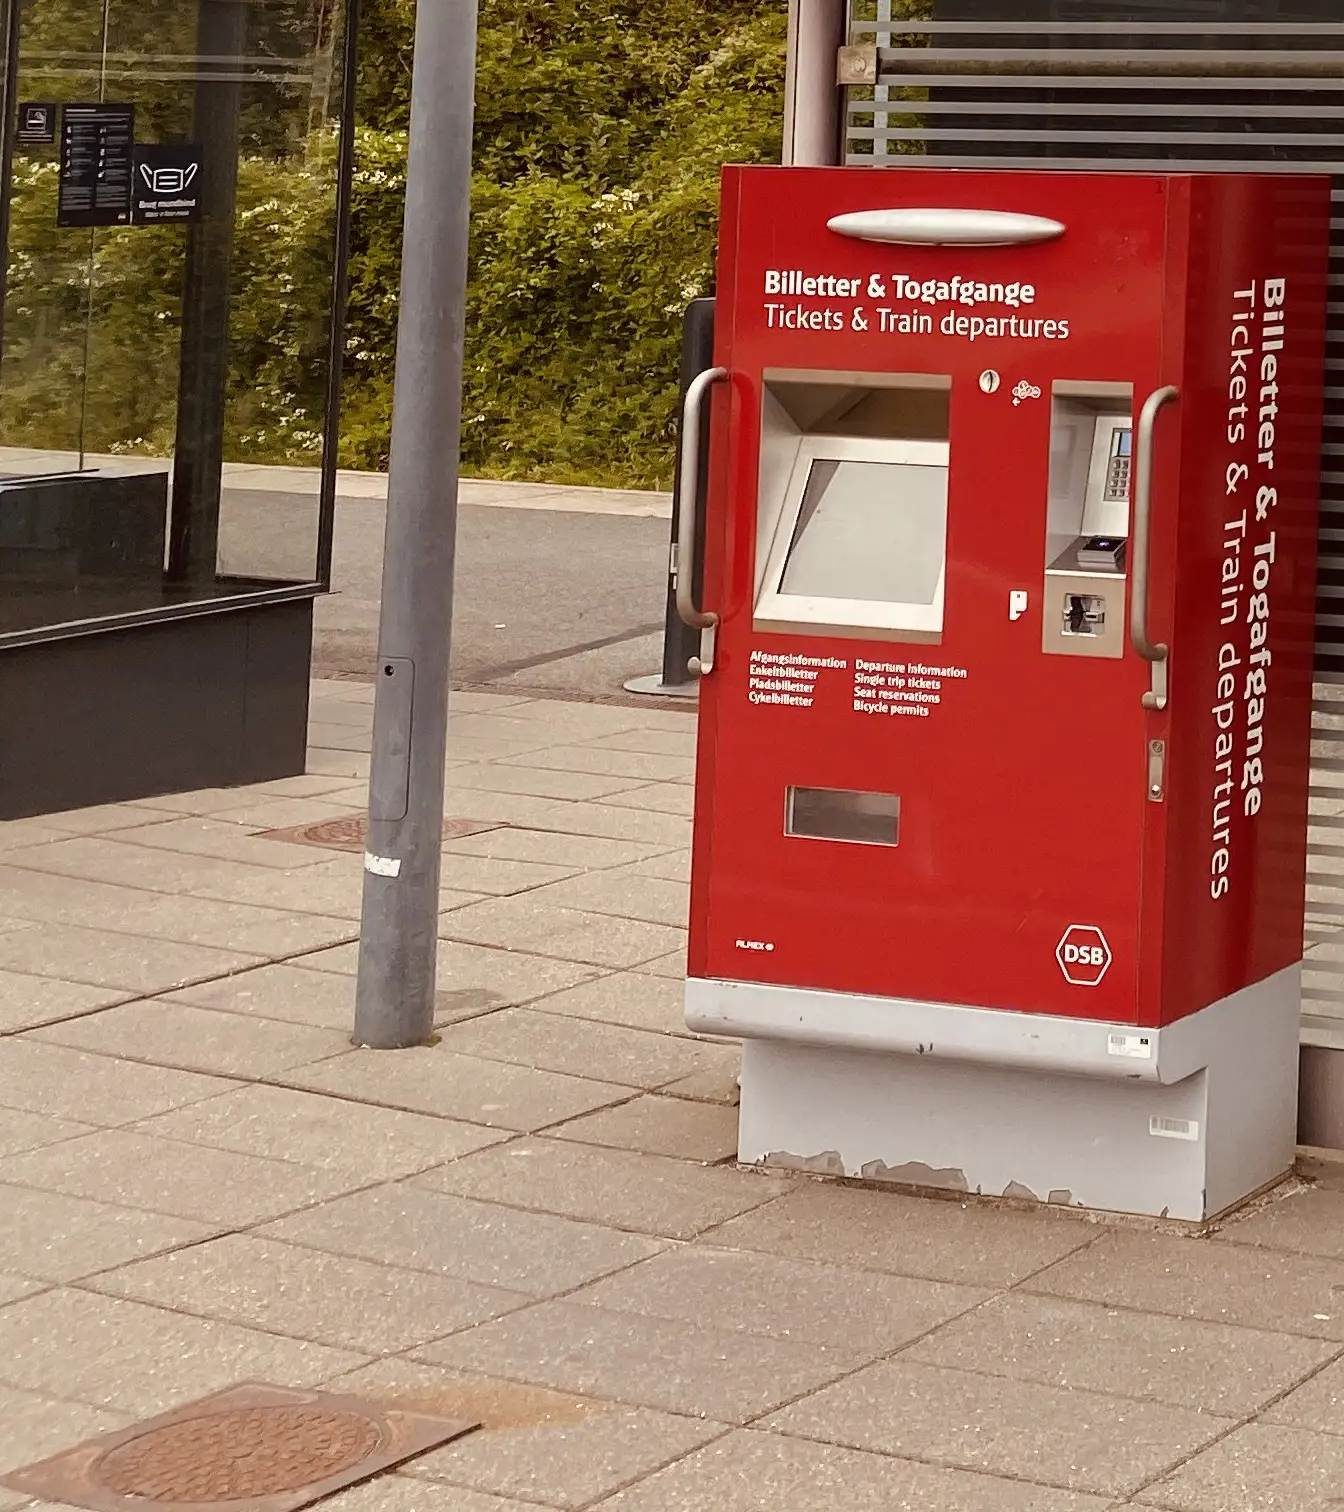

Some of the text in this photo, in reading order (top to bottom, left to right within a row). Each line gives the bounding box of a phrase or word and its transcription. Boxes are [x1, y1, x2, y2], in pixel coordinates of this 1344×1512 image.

[764, 269, 1035, 307] Billetter & Togafgange
[763, 303, 1069, 341] Tickets & Train departures
[1240, 277, 1286, 817] Billetter & Togafgange
[1210, 279, 1256, 900] Tickets & Train departures
[750, 650, 847, 669] Afgangsinformation
[855, 658, 968, 678] Departure information
[749, 664, 819, 680] Enkeltbilletter
[854, 673, 941, 690] Single trip tickets
[749, 678, 815, 693] Pladsbilletter
[854, 686, 941, 704] Seat reservations
[748, 691, 814, 707] Cykelbilletter
[854, 699, 930, 717] Bicycle permits
[1064, 944, 1104, 965] DSB
